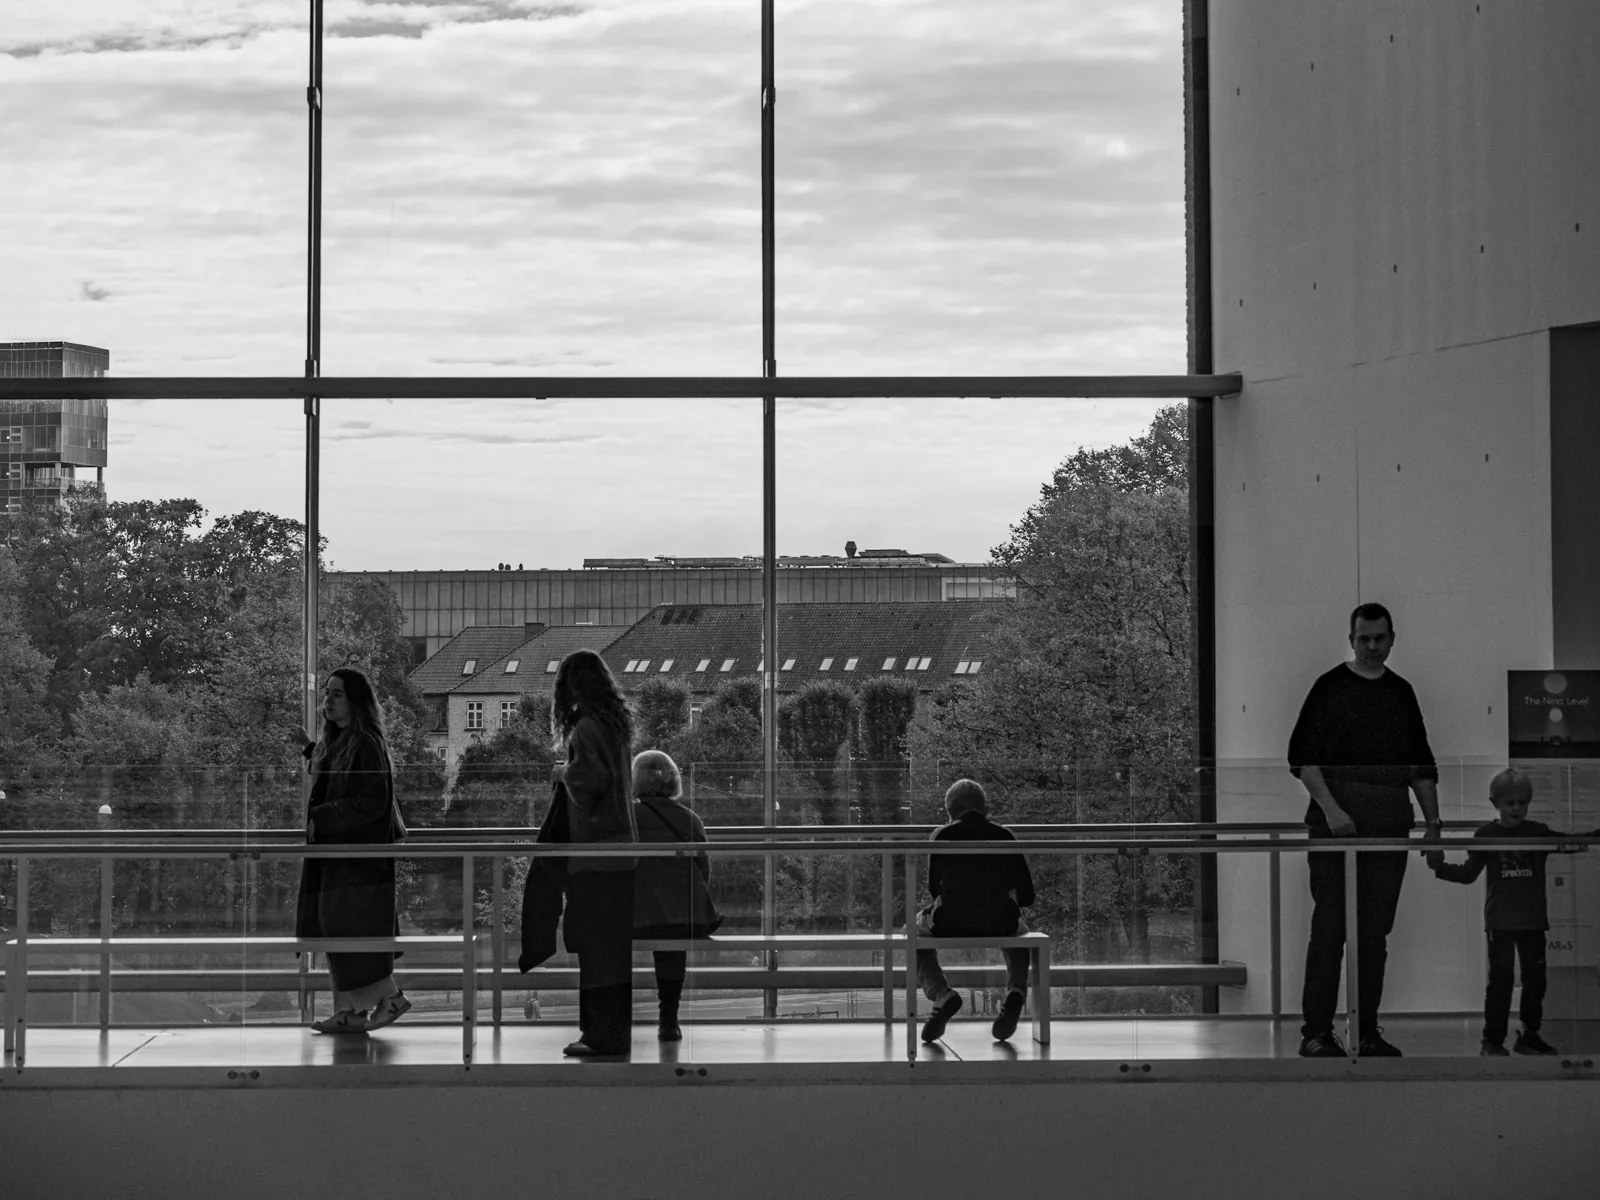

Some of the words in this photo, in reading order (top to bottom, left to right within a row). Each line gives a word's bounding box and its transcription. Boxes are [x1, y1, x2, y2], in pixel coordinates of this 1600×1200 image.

[1524, 696, 1540, 705] The
[1542, 696, 1563, 705] Next
[1566, 696, 1589, 705] Level
